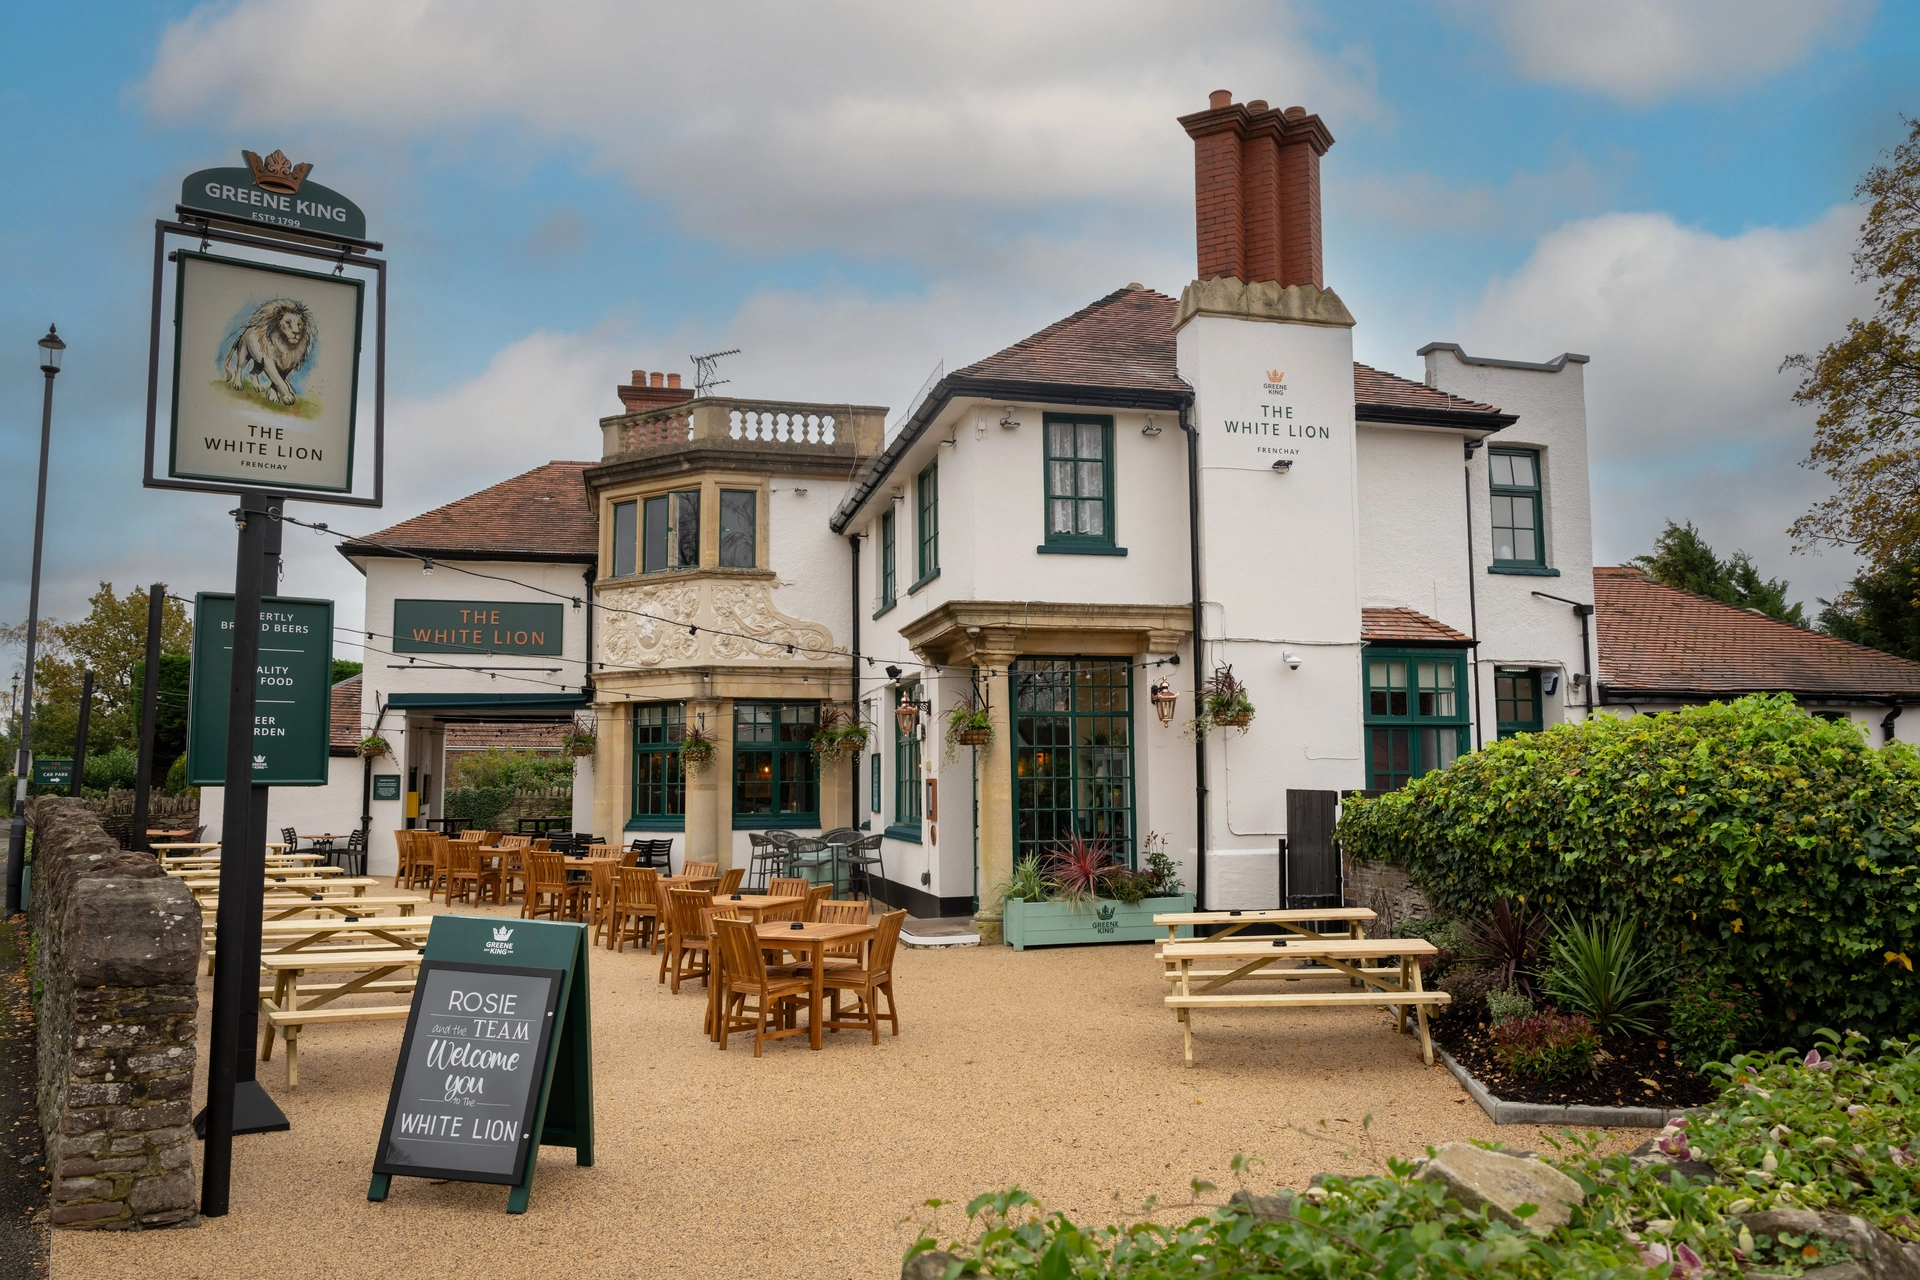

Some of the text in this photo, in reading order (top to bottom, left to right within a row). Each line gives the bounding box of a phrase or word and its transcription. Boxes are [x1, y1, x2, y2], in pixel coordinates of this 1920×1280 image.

[205, 182, 347, 222] GREENE KING
[277, 217, 300, 228] 1799
[1263, 383, 1288, 391] GREENE
[1261, 405, 1293, 419] THE
[247, 424, 284, 441] THE
[1224, 420, 1330, 439] WHITE LION
[204, 437, 323, 461] WHITE LION
[1257, 446, 1300, 455] FRENCHAY
[240, 460, 288, 471] FRENCHAY
[259, 612, 294, 622] ERTLY
[459, 609, 500, 625] THE
[274, 624, 309, 634] BEERS
[412, 628, 545, 646] WHITE LION
[256, 665, 289, 675] ALITY
[260, 676, 294, 686] FOOD
[254, 716, 276, 725] EER
[253, 727, 285, 736] RDEN
[1092, 921, 1118, 929] GREENE
[486, 941, 514, 949] GREENE
[490, 947, 507, 955] KING
[448, 990, 518, 1015] ROSIE
[431, 1019, 529, 1040] and the TEAM
[427, 1039, 520, 1071] Welcome
[444, 1074, 484, 1102] you
[452, 1096, 461, 1105] to
[401, 1113, 518, 1142] WHITE LION
